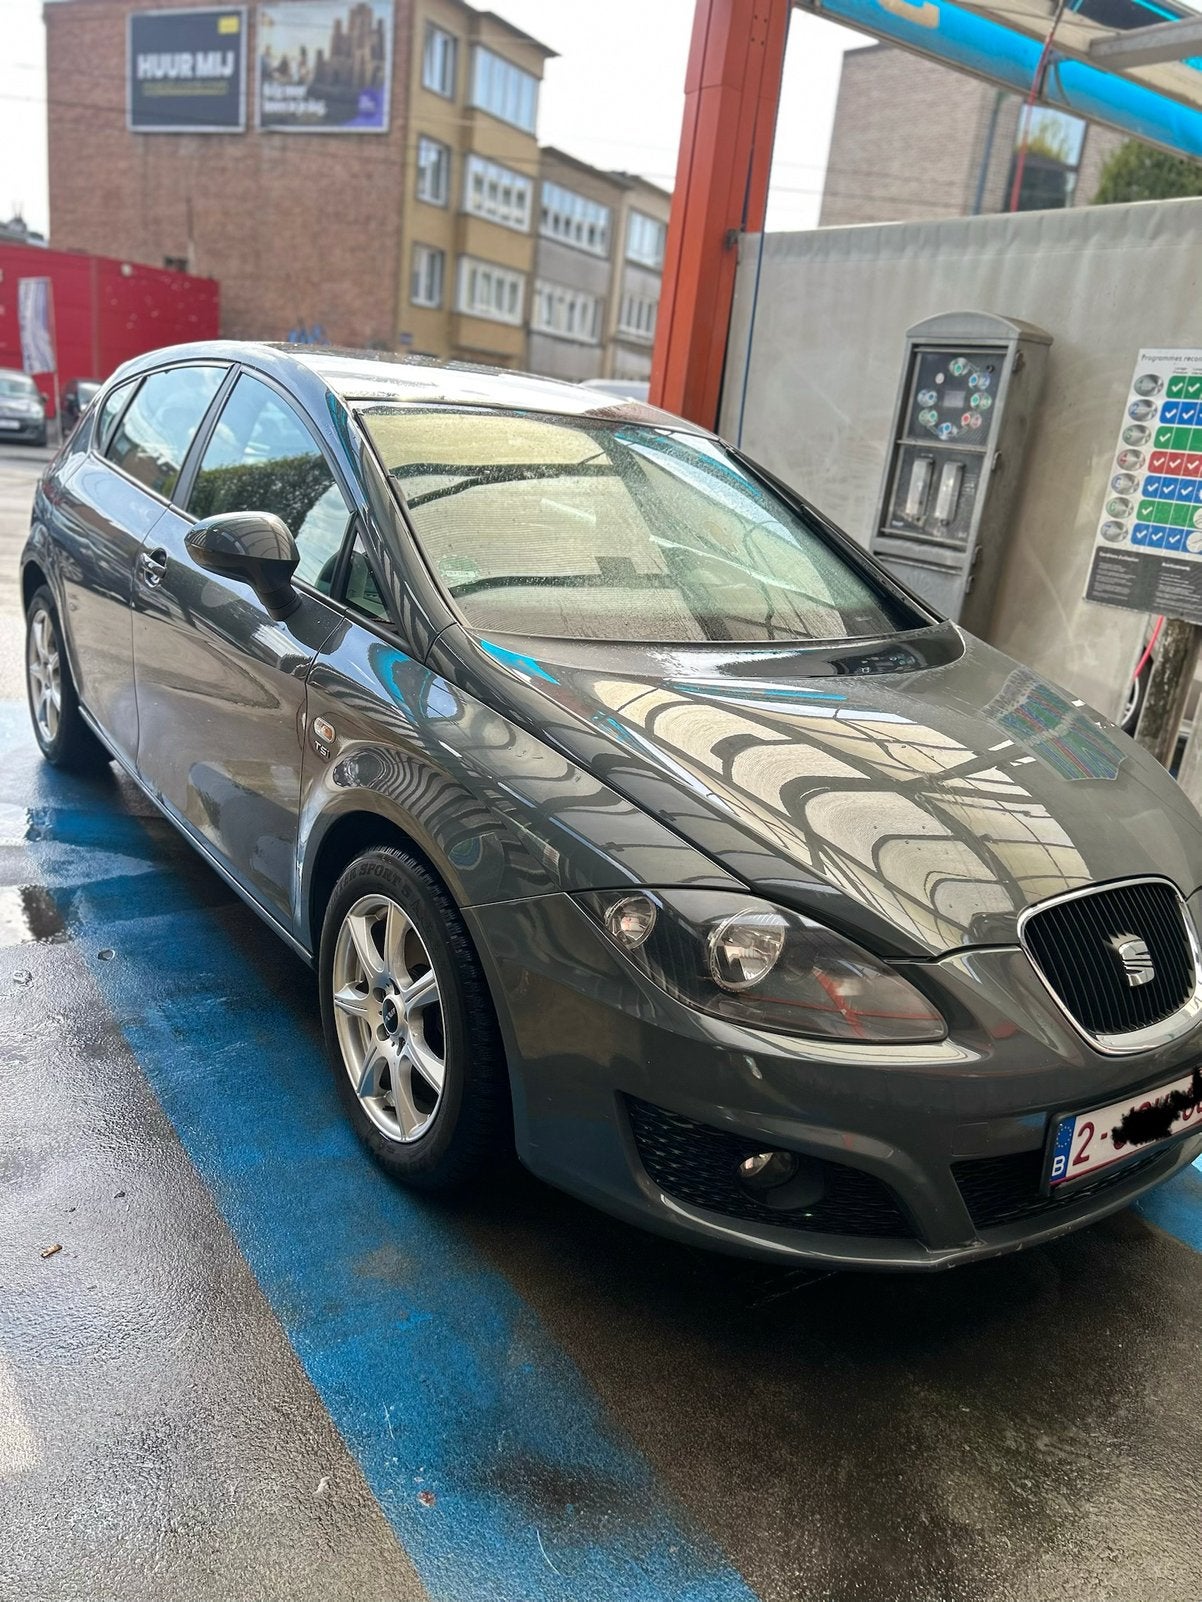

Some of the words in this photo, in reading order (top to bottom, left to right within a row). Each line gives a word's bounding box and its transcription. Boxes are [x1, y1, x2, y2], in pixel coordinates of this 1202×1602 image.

[138, 53, 192, 79] HUUR
[196, 51, 234, 77] MIJ
[1141, 354, 1182, 363] Programmes
[1051, 1155, 1066, 1177] B
